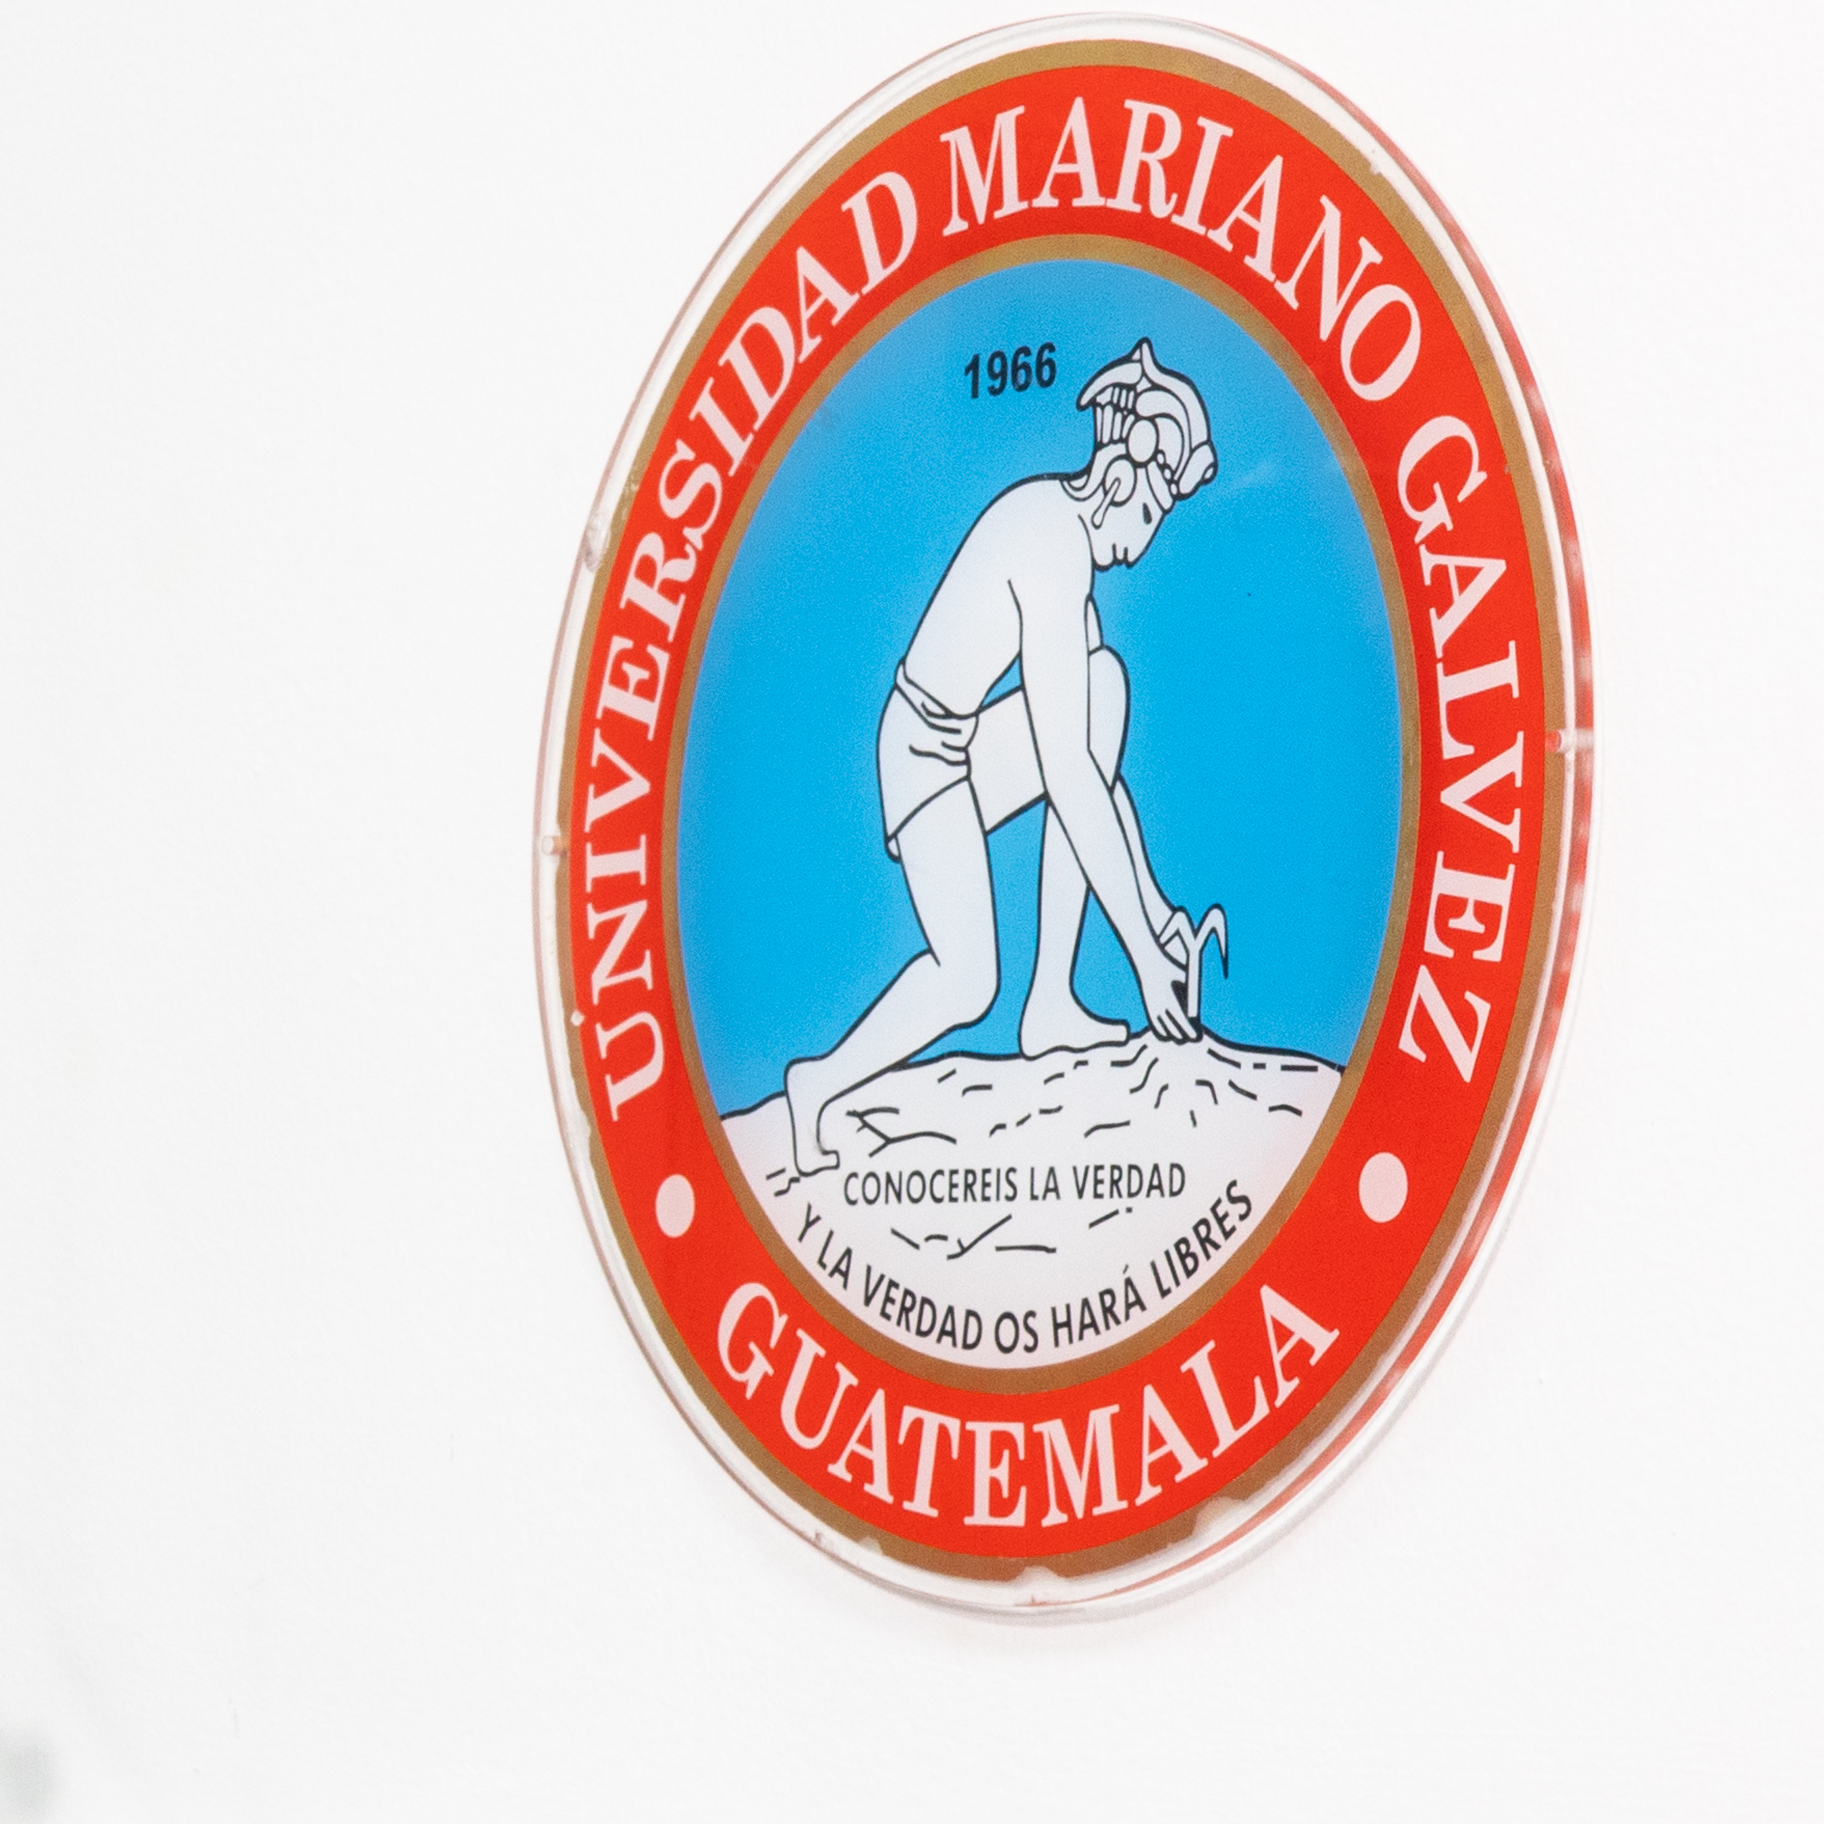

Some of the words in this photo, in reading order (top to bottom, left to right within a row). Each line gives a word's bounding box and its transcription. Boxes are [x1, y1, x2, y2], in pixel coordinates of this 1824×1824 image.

[964, 342, 1057, 399] 1966
[583, 171, 918, 1121] UNIVERSIDAD
[940, 96, 1422, 402] MARIANO
[1397, 415, 1524, 1083] GALVEZ
[797, 1202, 822, 1243] Y
[817, 1229, 853, 1291] LA
[864, 1264, 983, 1351] VERDAD
[994, 1310, 1039, 1355] OS
[1051, 1264, 1147, 1348] HARÁ
[1150, 1179, 1253, 1299] LIBRES
[843, 1167, 1018, 1206] CONOCEREIS
[1029, 1166, 1061, 1202] LA
[1072, 1163, 1186, 1199] VERDAD
[717, 1282, 1340, 1528] GUATEMALA
